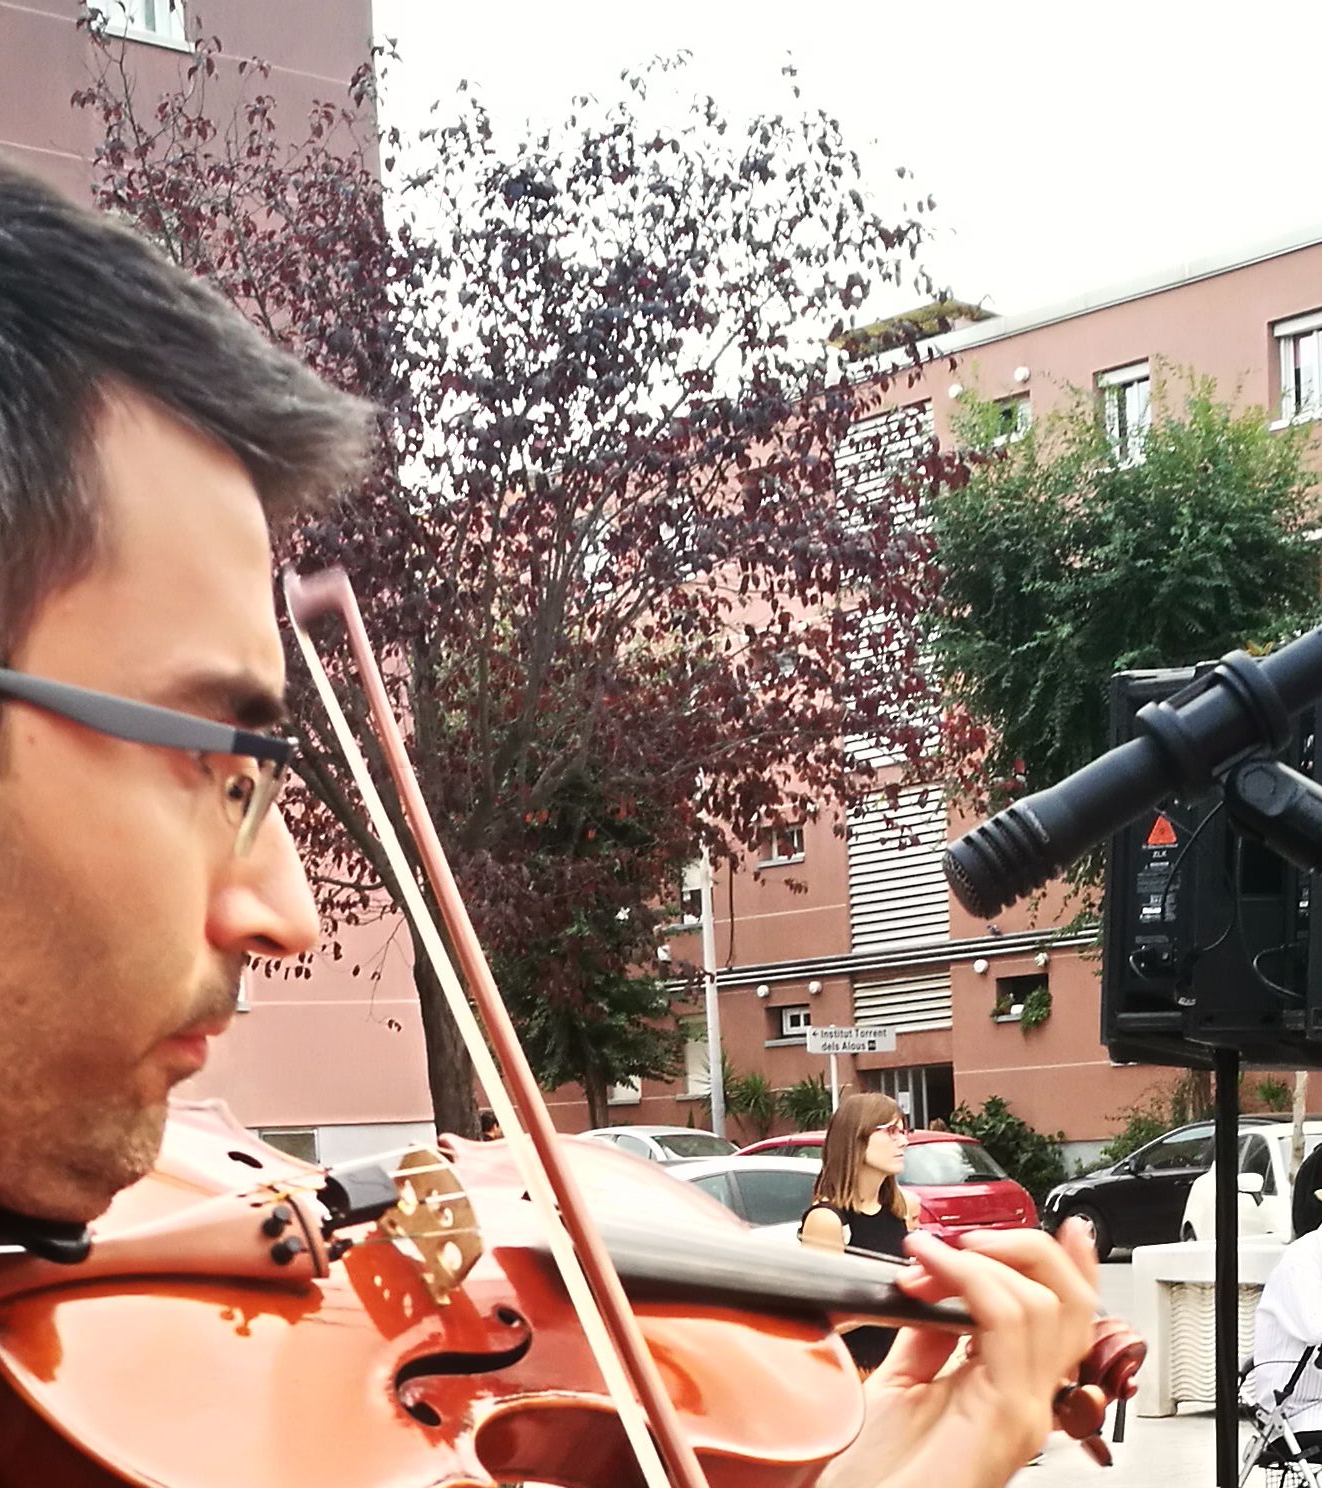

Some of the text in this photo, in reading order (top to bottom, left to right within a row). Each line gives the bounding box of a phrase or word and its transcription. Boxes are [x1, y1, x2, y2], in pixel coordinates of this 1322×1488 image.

[821, 1028, 887, 1038] Institut Torrent
[822, 1041, 840, 1051] dels
